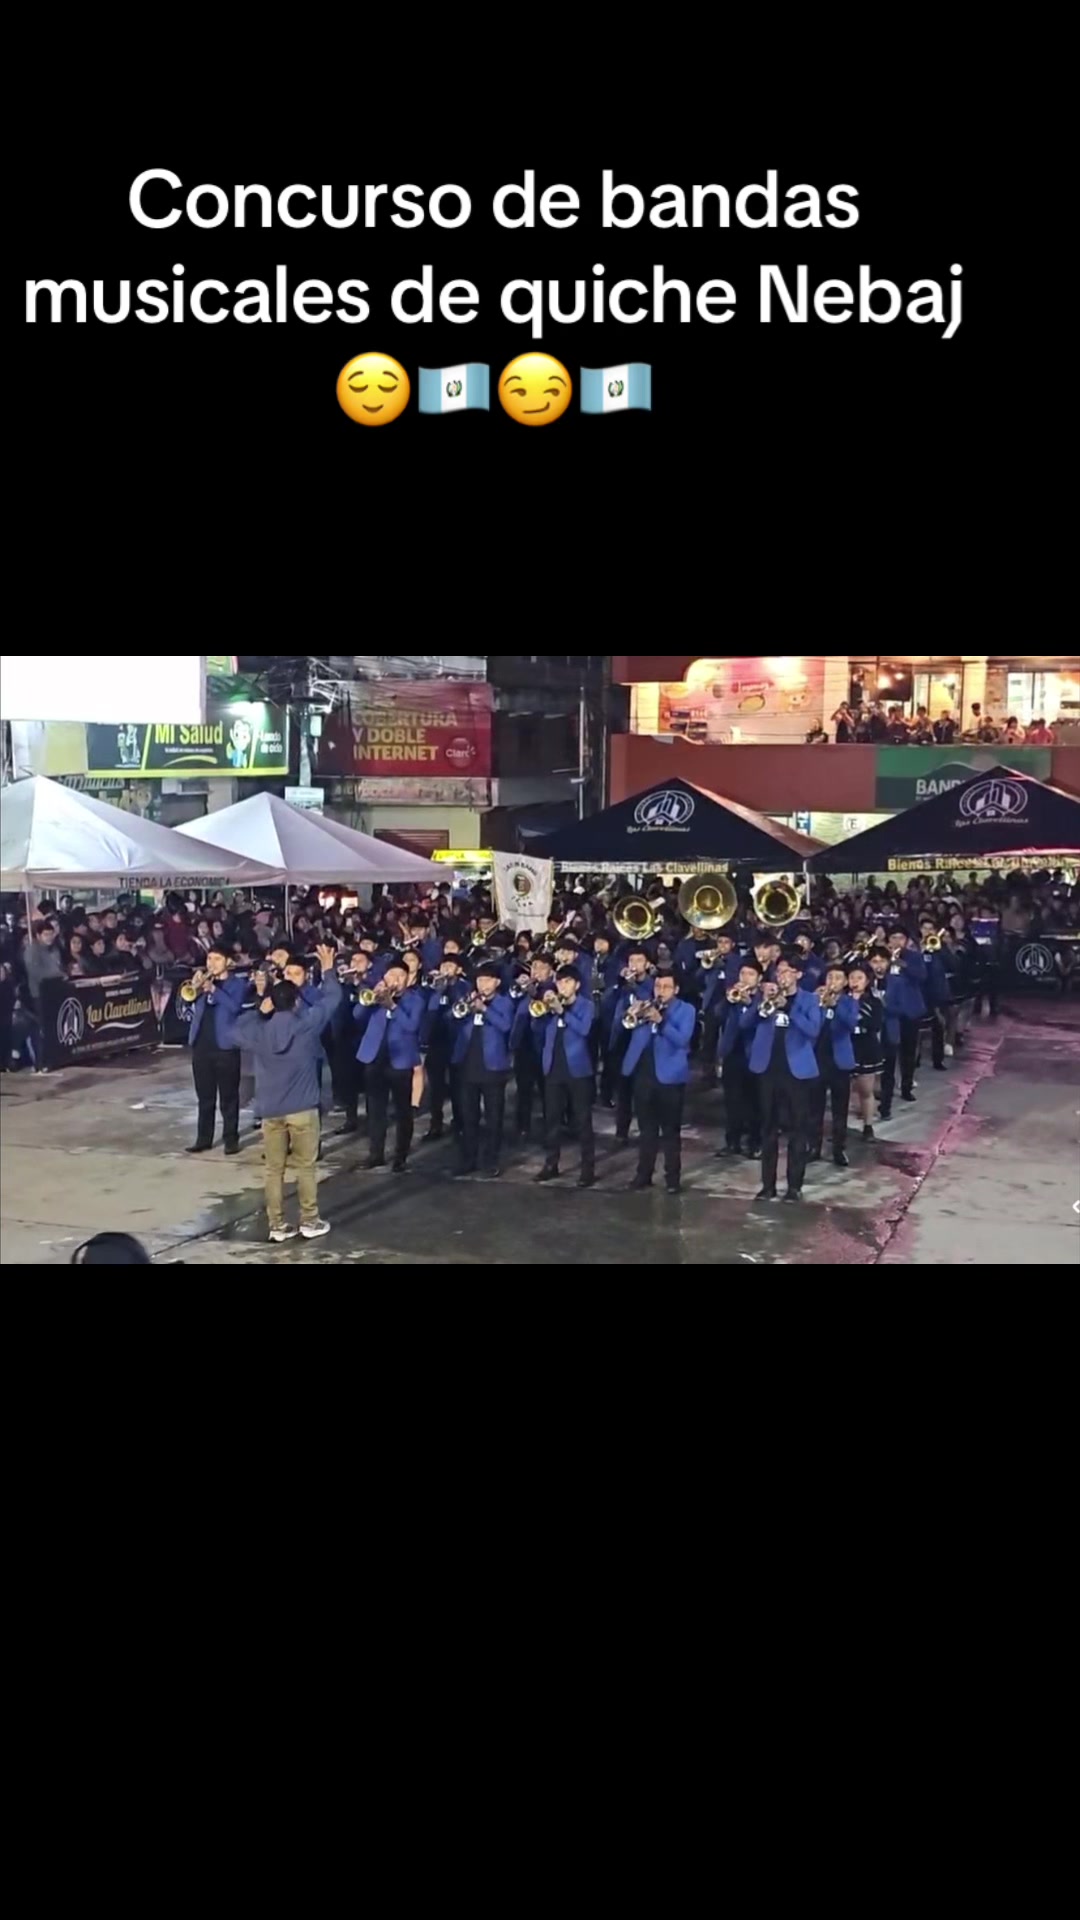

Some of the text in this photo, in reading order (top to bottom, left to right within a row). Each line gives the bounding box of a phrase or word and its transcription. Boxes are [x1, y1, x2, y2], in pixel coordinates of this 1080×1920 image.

[352, 711, 458, 727] COBERTURA
[179, 720, 224, 745] Salud
[352, 727, 427, 744] Y DOBLE
[352, 744, 439, 761] INTERNET
[642, 862, 661, 873] Las
[665, 861, 728, 873] Clavellinas
[118, 877, 156, 889] TIENDA
[160, 877, 172, 888] LA
[86, 998, 152, 1028] Las Clavellinas
